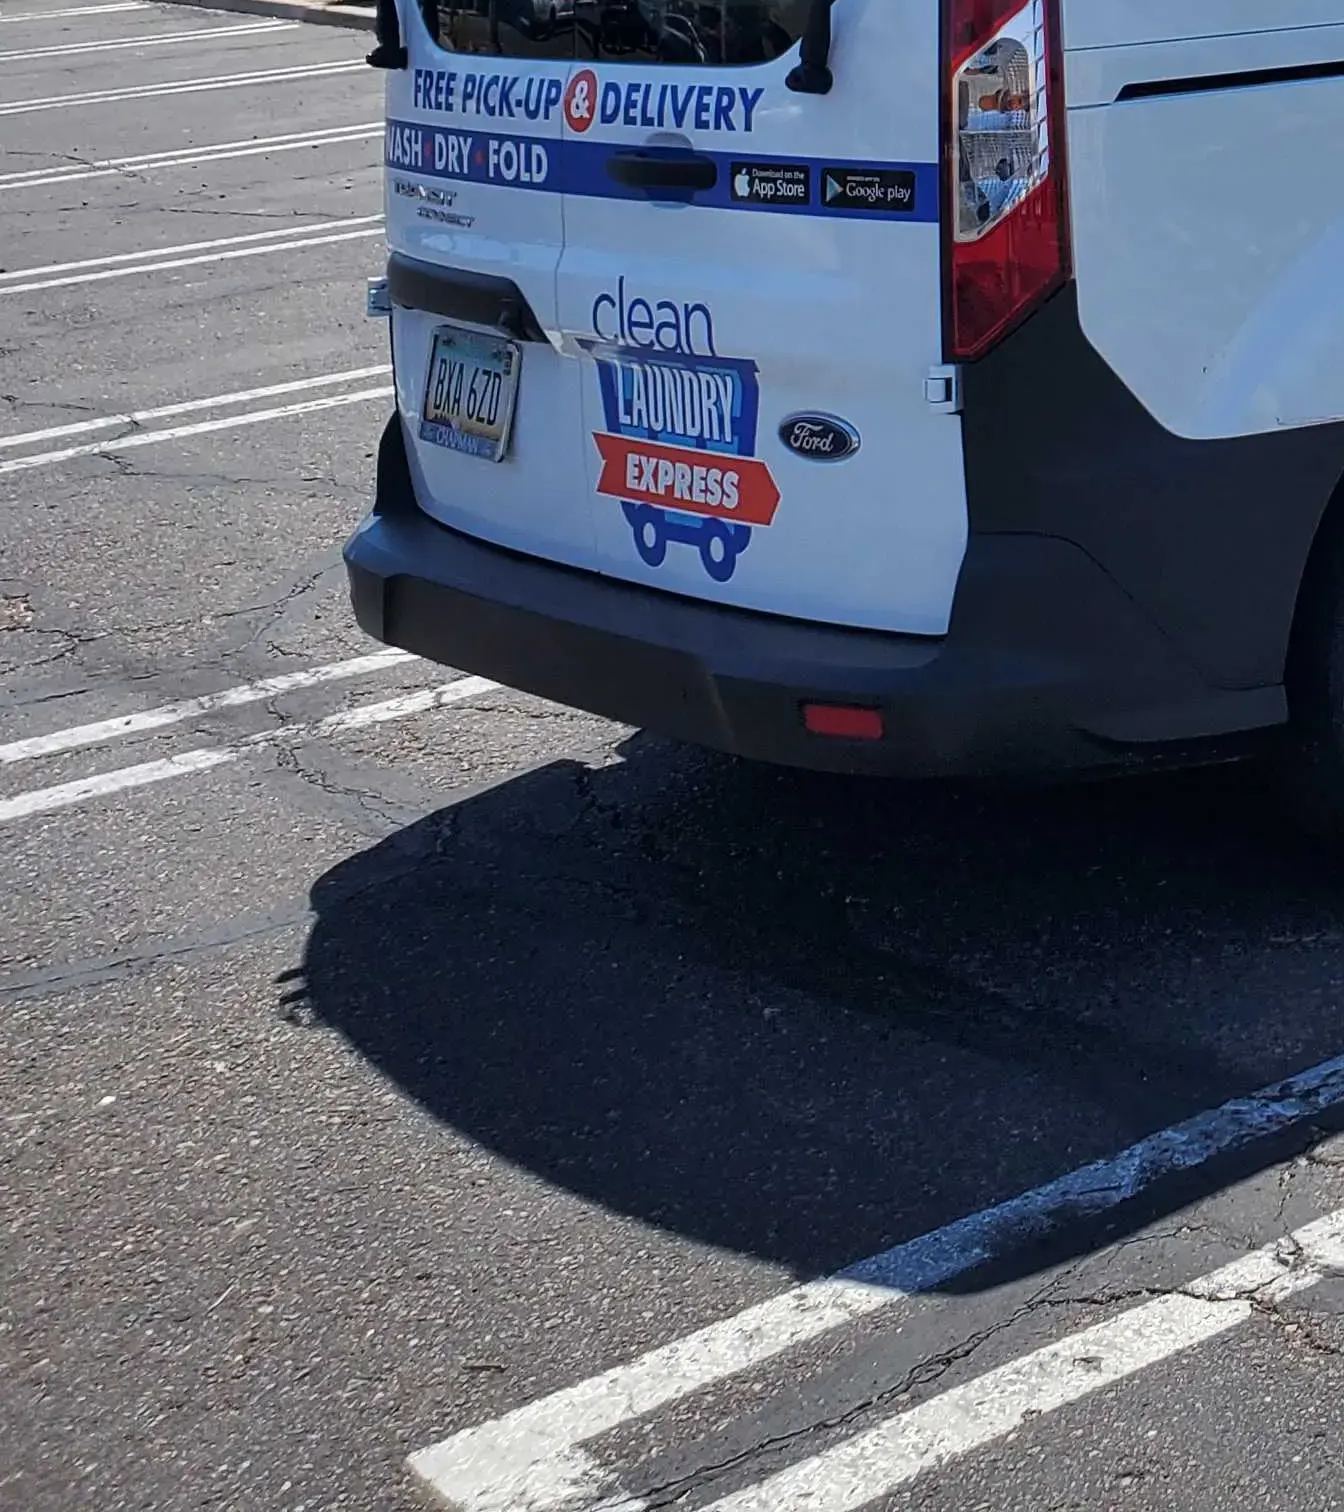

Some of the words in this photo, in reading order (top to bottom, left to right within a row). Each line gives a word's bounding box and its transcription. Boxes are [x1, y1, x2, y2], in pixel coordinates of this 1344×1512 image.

[413, 68, 457, 112] FREE
[462, 74, 563, 122] PICK-UP
[569, 79, 591, 120] &
[601, 82, 766, 132] DELIVERY
[434, 133, 473, 174] DRY
[488, 140, 548, 183] FOLD
[752, 168, 783, 180] Download
[753, 179, 775, 198] App
[776, 182, 805, 197] Store
[846, 182, 884, 202] Google
[887, 185, 911, 202] play
[592, 276, 717, 357] clean
[433, 357, 465, 417] BXA
[615, 359, 734, 444] LAUNDRY
[789, 421, 836, 453] Ford
[626, 452, 741, 510] EXPRESS
